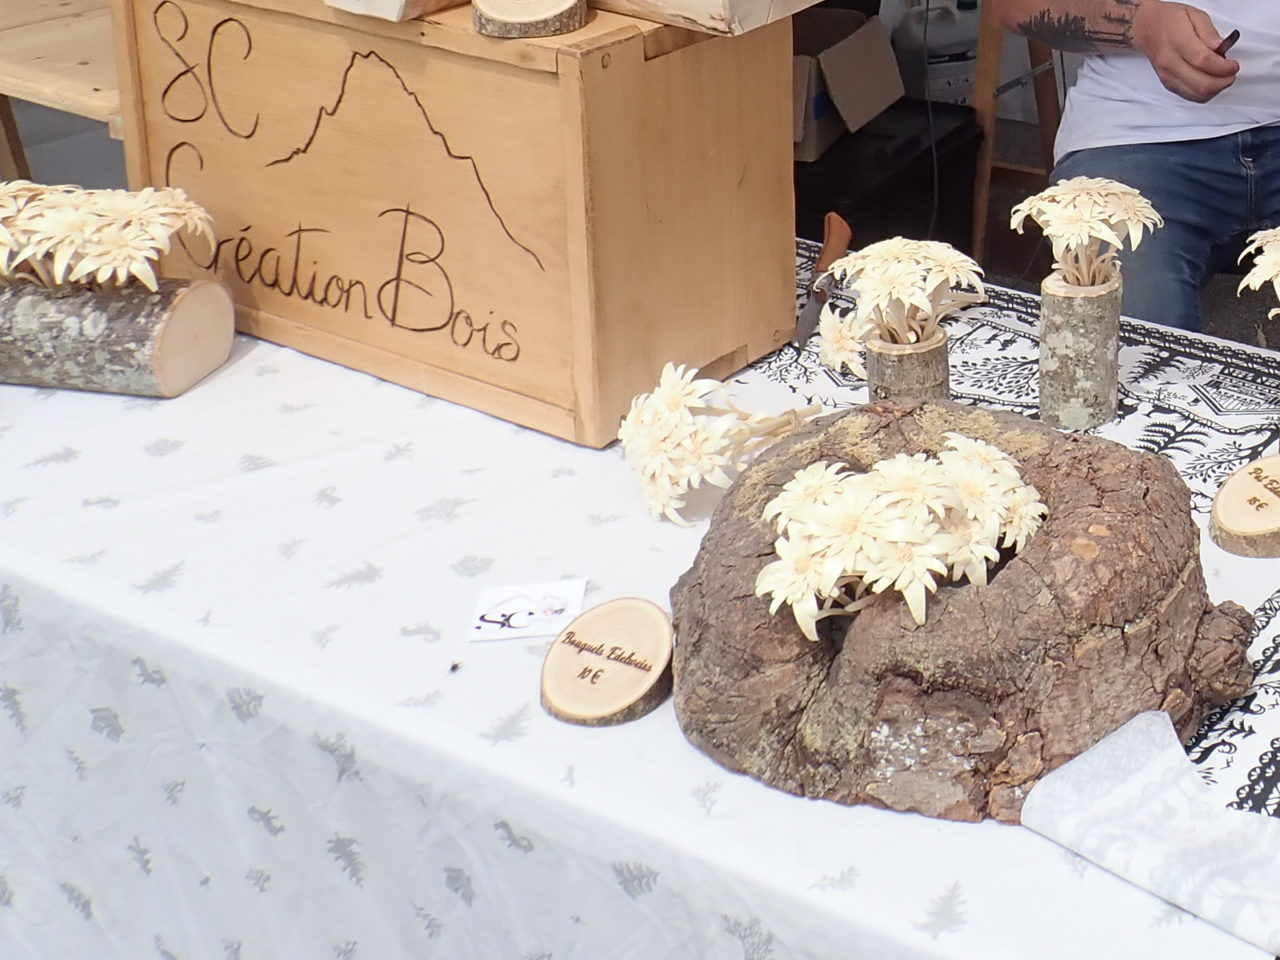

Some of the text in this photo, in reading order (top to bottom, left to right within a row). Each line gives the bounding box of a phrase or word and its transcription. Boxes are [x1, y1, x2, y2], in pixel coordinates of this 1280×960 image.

[377, 203, 521, 363] Bois
[1256, 502, 1268, 512] €
[561, 630, 653, 673] Bouquets Edelweiss
[590, 669, 604, 685] €
